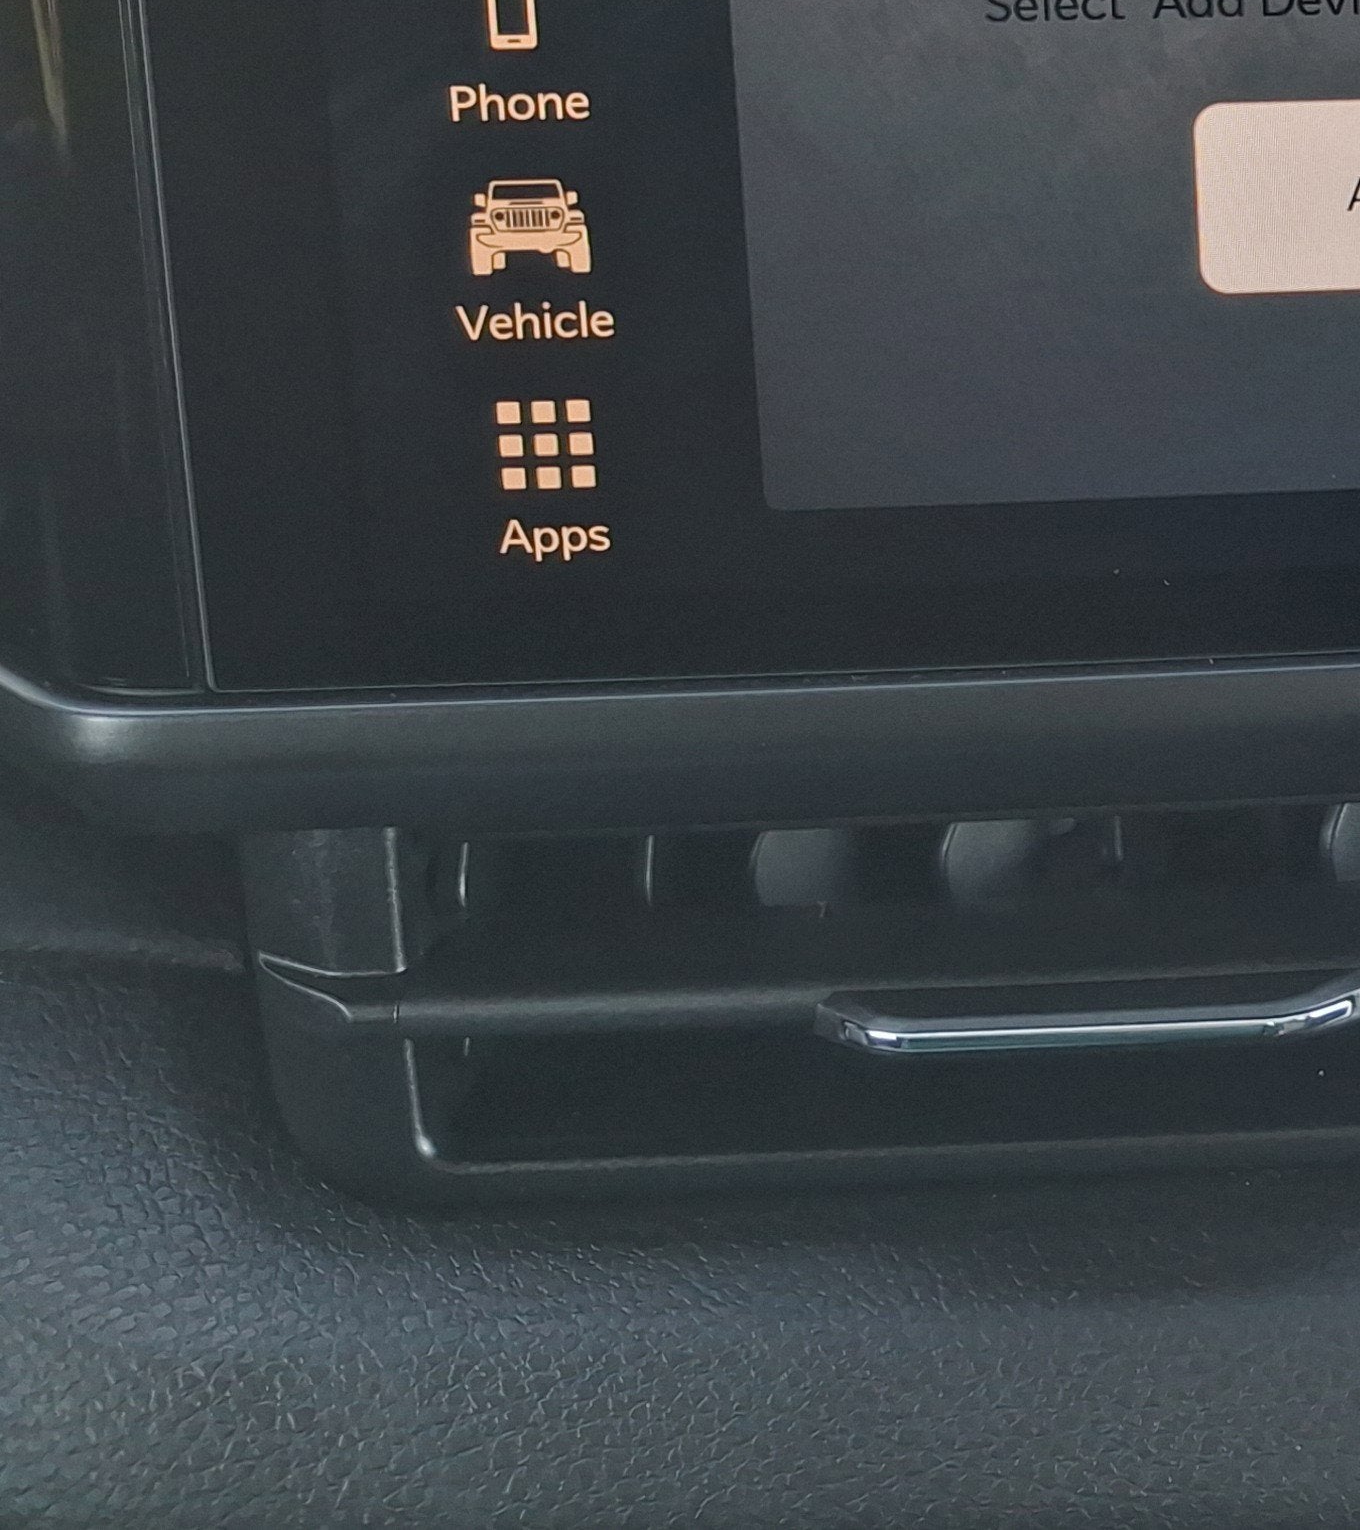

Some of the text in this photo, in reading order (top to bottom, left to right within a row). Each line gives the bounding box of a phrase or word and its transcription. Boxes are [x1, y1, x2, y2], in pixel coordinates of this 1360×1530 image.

[448, 84, 591, 123] Phone
[454, 302, 617, 341] Vehicle
[500, 519, 611, 561] Apps
